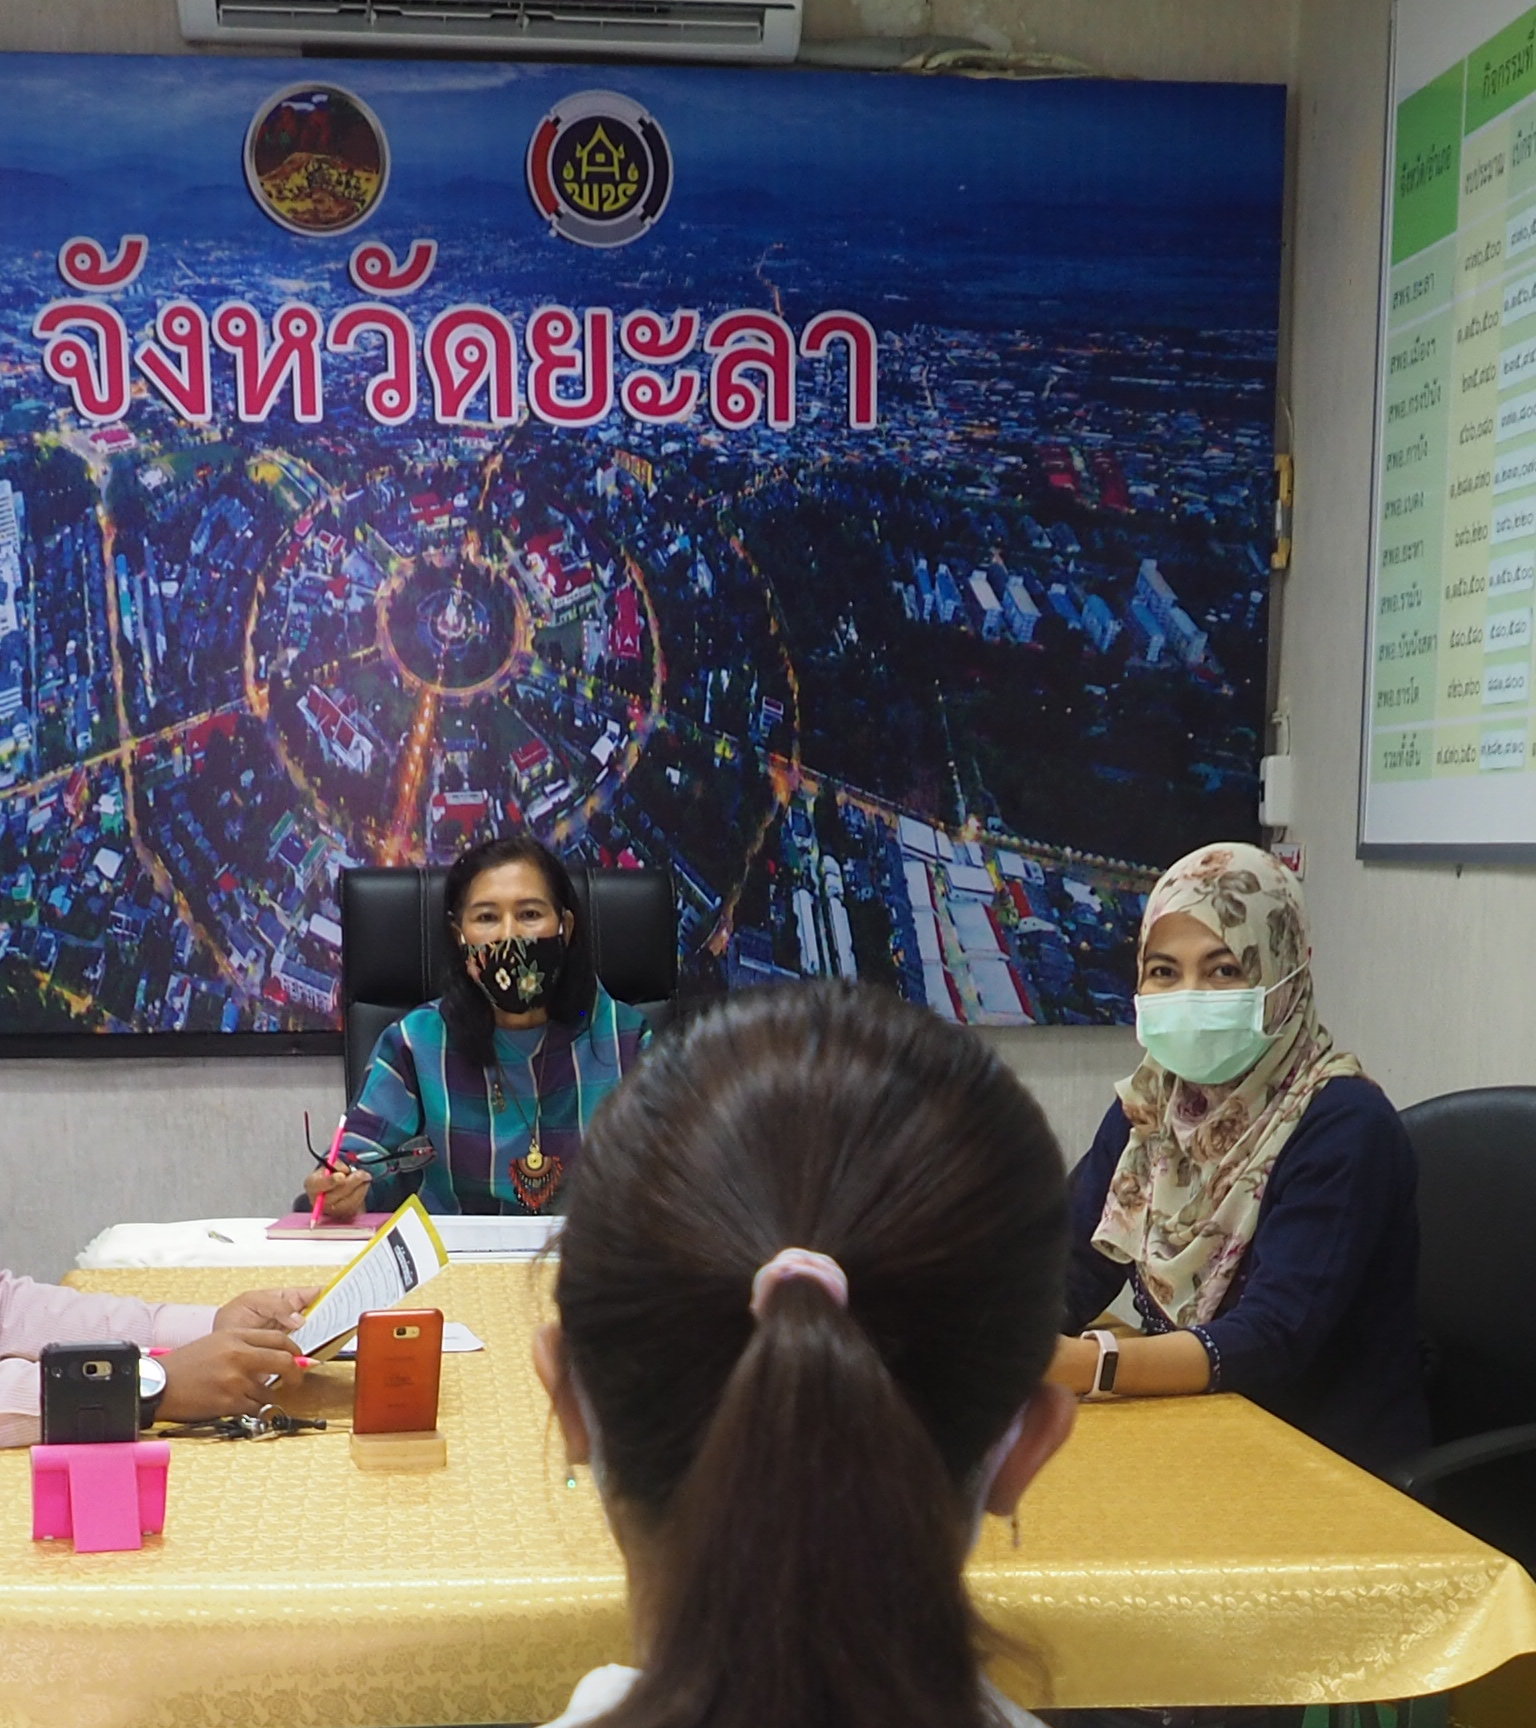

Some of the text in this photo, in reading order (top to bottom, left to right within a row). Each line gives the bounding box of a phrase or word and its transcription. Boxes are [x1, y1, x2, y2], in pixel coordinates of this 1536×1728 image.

[33, 233, 878, 430] จังหวัดยะลา
